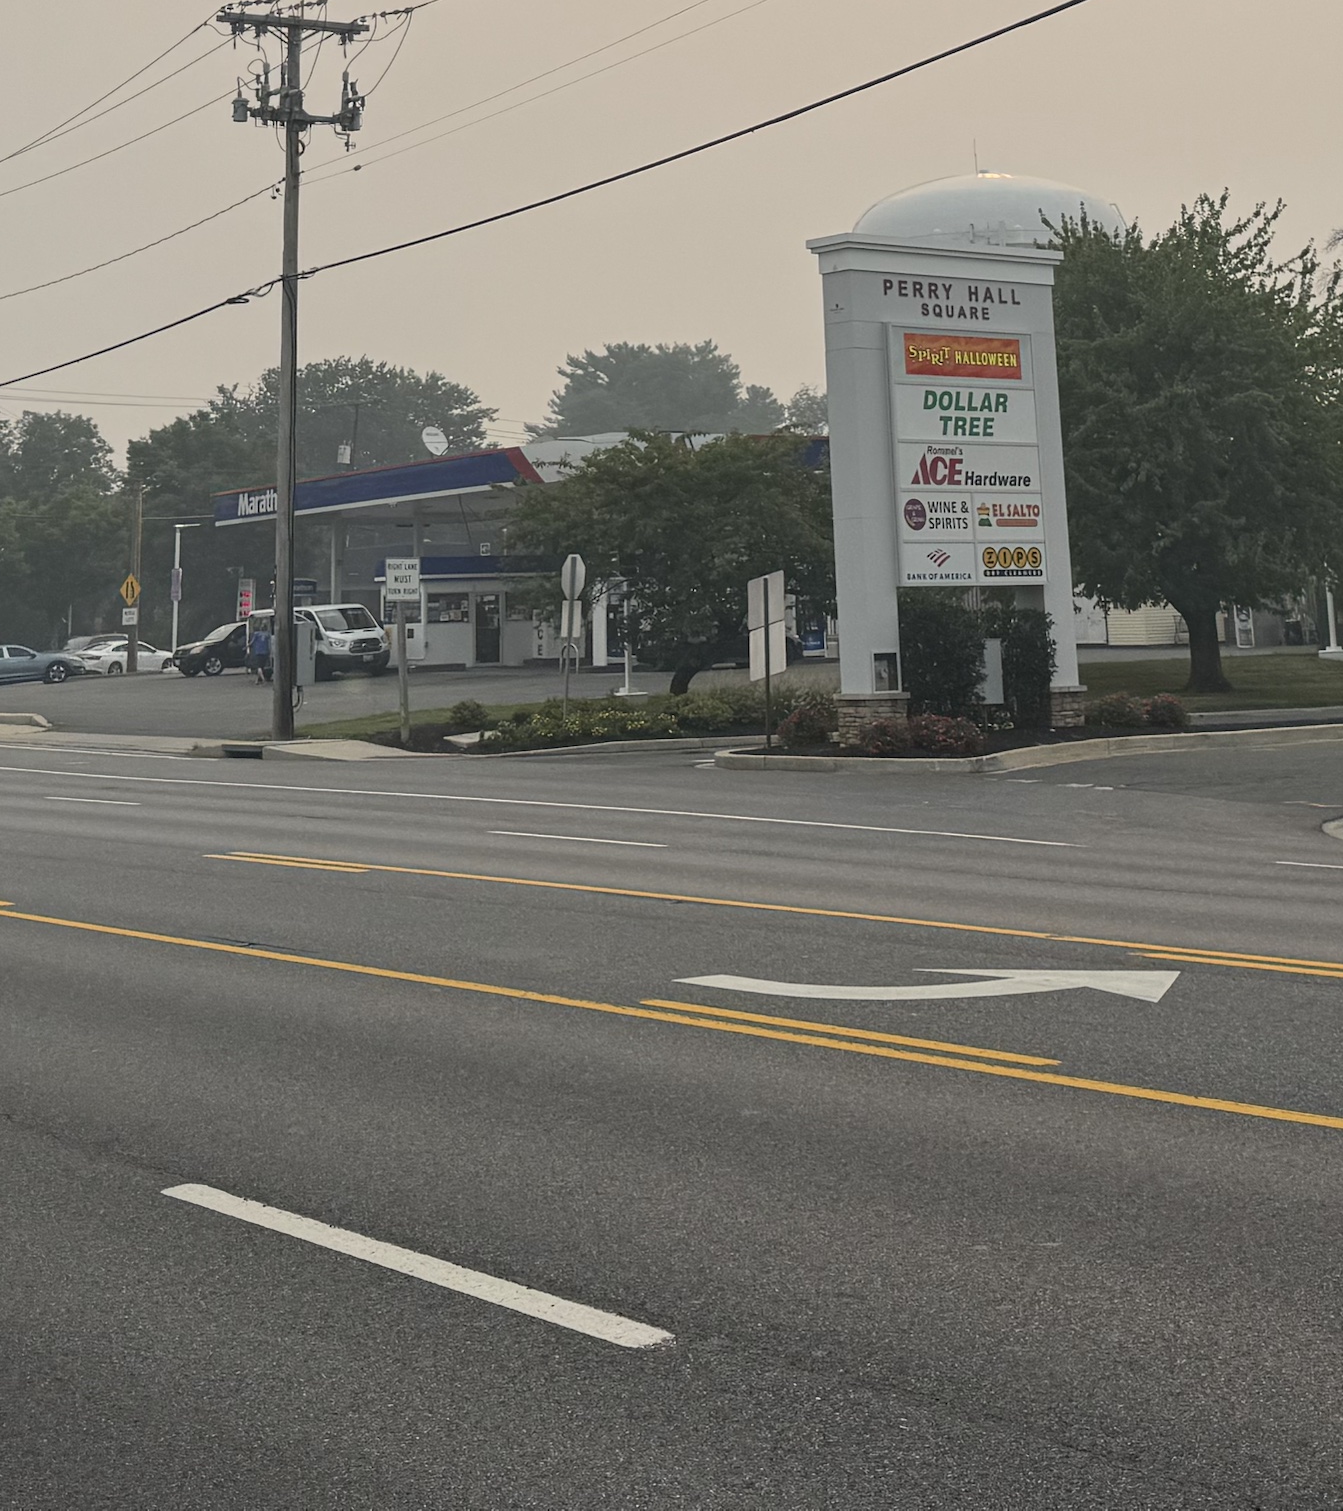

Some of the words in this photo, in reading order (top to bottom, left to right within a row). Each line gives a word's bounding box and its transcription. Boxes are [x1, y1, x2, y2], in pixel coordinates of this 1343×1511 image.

[883, 279, 953, 300] PERRY
[968, 285, 1021, 306] HALL
[921, 303, 990, 321] SQUARE
[908, 345, 950, 366] SPIRIT
[955, 351, 1017, 367] HALLOWEEN
[923, 390, 1008, 413] DOLLAR
[939, 416, 994, 437] TREE
[911, 452, 963, 486] ACE
[965, 471, 1031, 487] Hardware
[237, 488, 278, 516] Marath
[927, 500, 957, 514] WINE
[960, 500, 969, 514] &
[992, 503, 1005, 518] EL
[1007, 504, 1040, 518] SALTO
[928, 517, 969, 530] SPIRITS
[982, 547, 1042, 568] ZIPS
[394, 574, 412, 584] MUST
